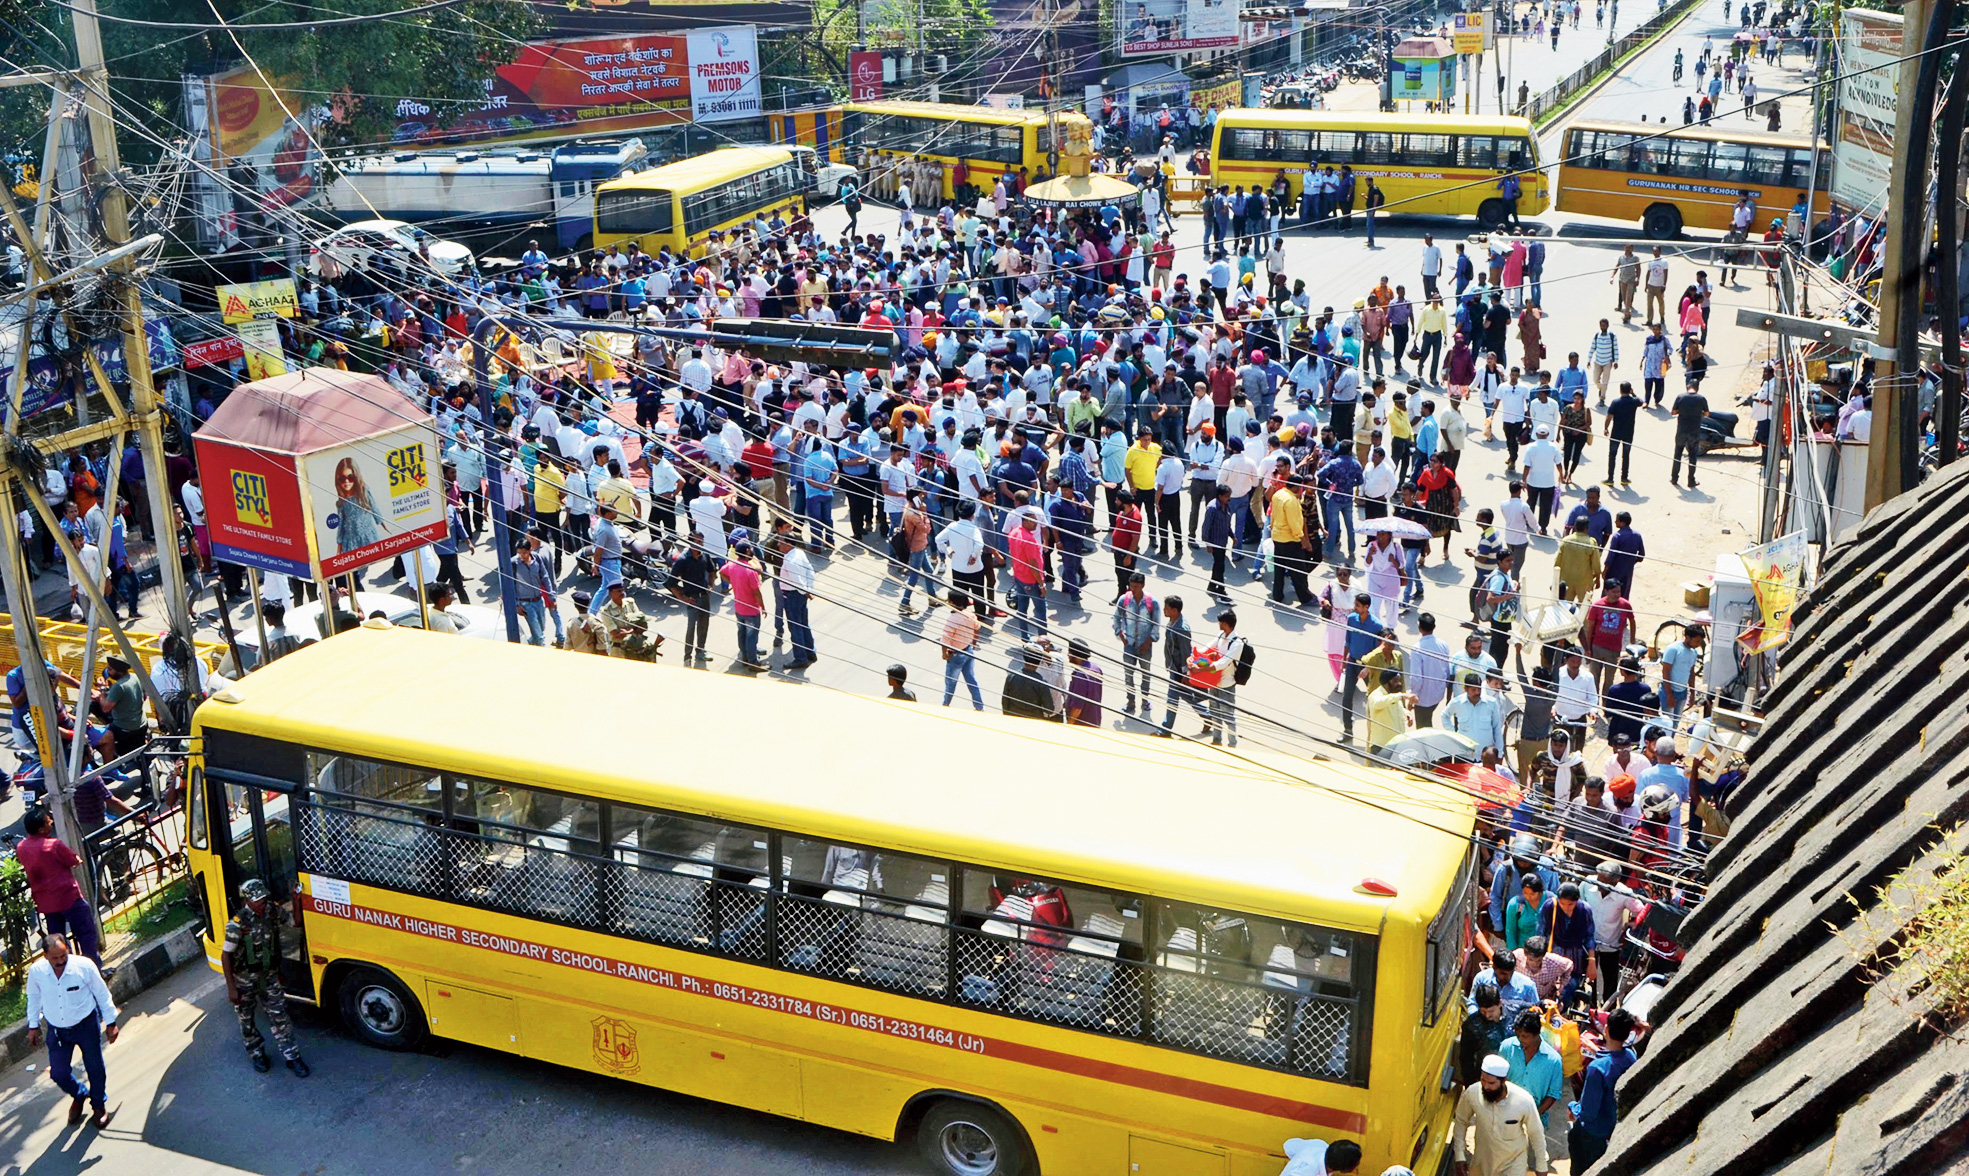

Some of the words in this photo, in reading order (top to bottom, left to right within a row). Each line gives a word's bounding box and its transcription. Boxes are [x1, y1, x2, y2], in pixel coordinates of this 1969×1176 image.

[1467, 16, 1481, 26] LIC
[614, 51, 626, 64] एवं
[660, 48, 673, 58] का
[589, 67, 610, 80] सबसे
[612, 65, 638, 78] विशाल
[697, 60, 750, 77] PREMSONS
[581, 83, 606, 96] निरंतर
[635, 78, 651, 90] सेवा
[661, 77, 680, 87] तत्पर
[708, 78, 742, 93] MOTOR
[860, 88, 876, 100] LG
[1628, 179, 1677, 190] GURUNANAK
[1709, 187, 1739, 196] SCHOOL
[387, 444, 424, 470] CITI
[232, 472, 267, 498] CITI
[392, 498, 403, 506] THE
[404, 491, 430, 505] ULTIMATE
[393, 505, 413, 515] FAMILY
[413, 499, 430, 509] STORE
[222, 523, 233, 532] THE
[233, 527, 257, 538] ULTIMATE
[257, 531, 275, 541] FAMILY
[276, 536, 292, 546] STORE
[228, 547, 243, 558] Sujata
[243, 551, 257, 560] Chowk
[332, 554, 355, 567] Sujata
[356, 545, 380, 559] Chowk
[384, 535, 411, 550] Sarjana
[411, 528, 434, 540] Chowk
[314, 899, 351, 918] GURU
[355, 907, 402, 930] NANAK
[404, 918, 457, 941] HIGHER
[461, 931, 548, 959] SECONDARY
[713, 982, 812, 1017] 0651-2331784
[815, 1004, 847, 1025] (Sr.)
[850, 1011, 954, 1047] 0651-2331464
[958, 1034, 985, 1054] (Jr)
